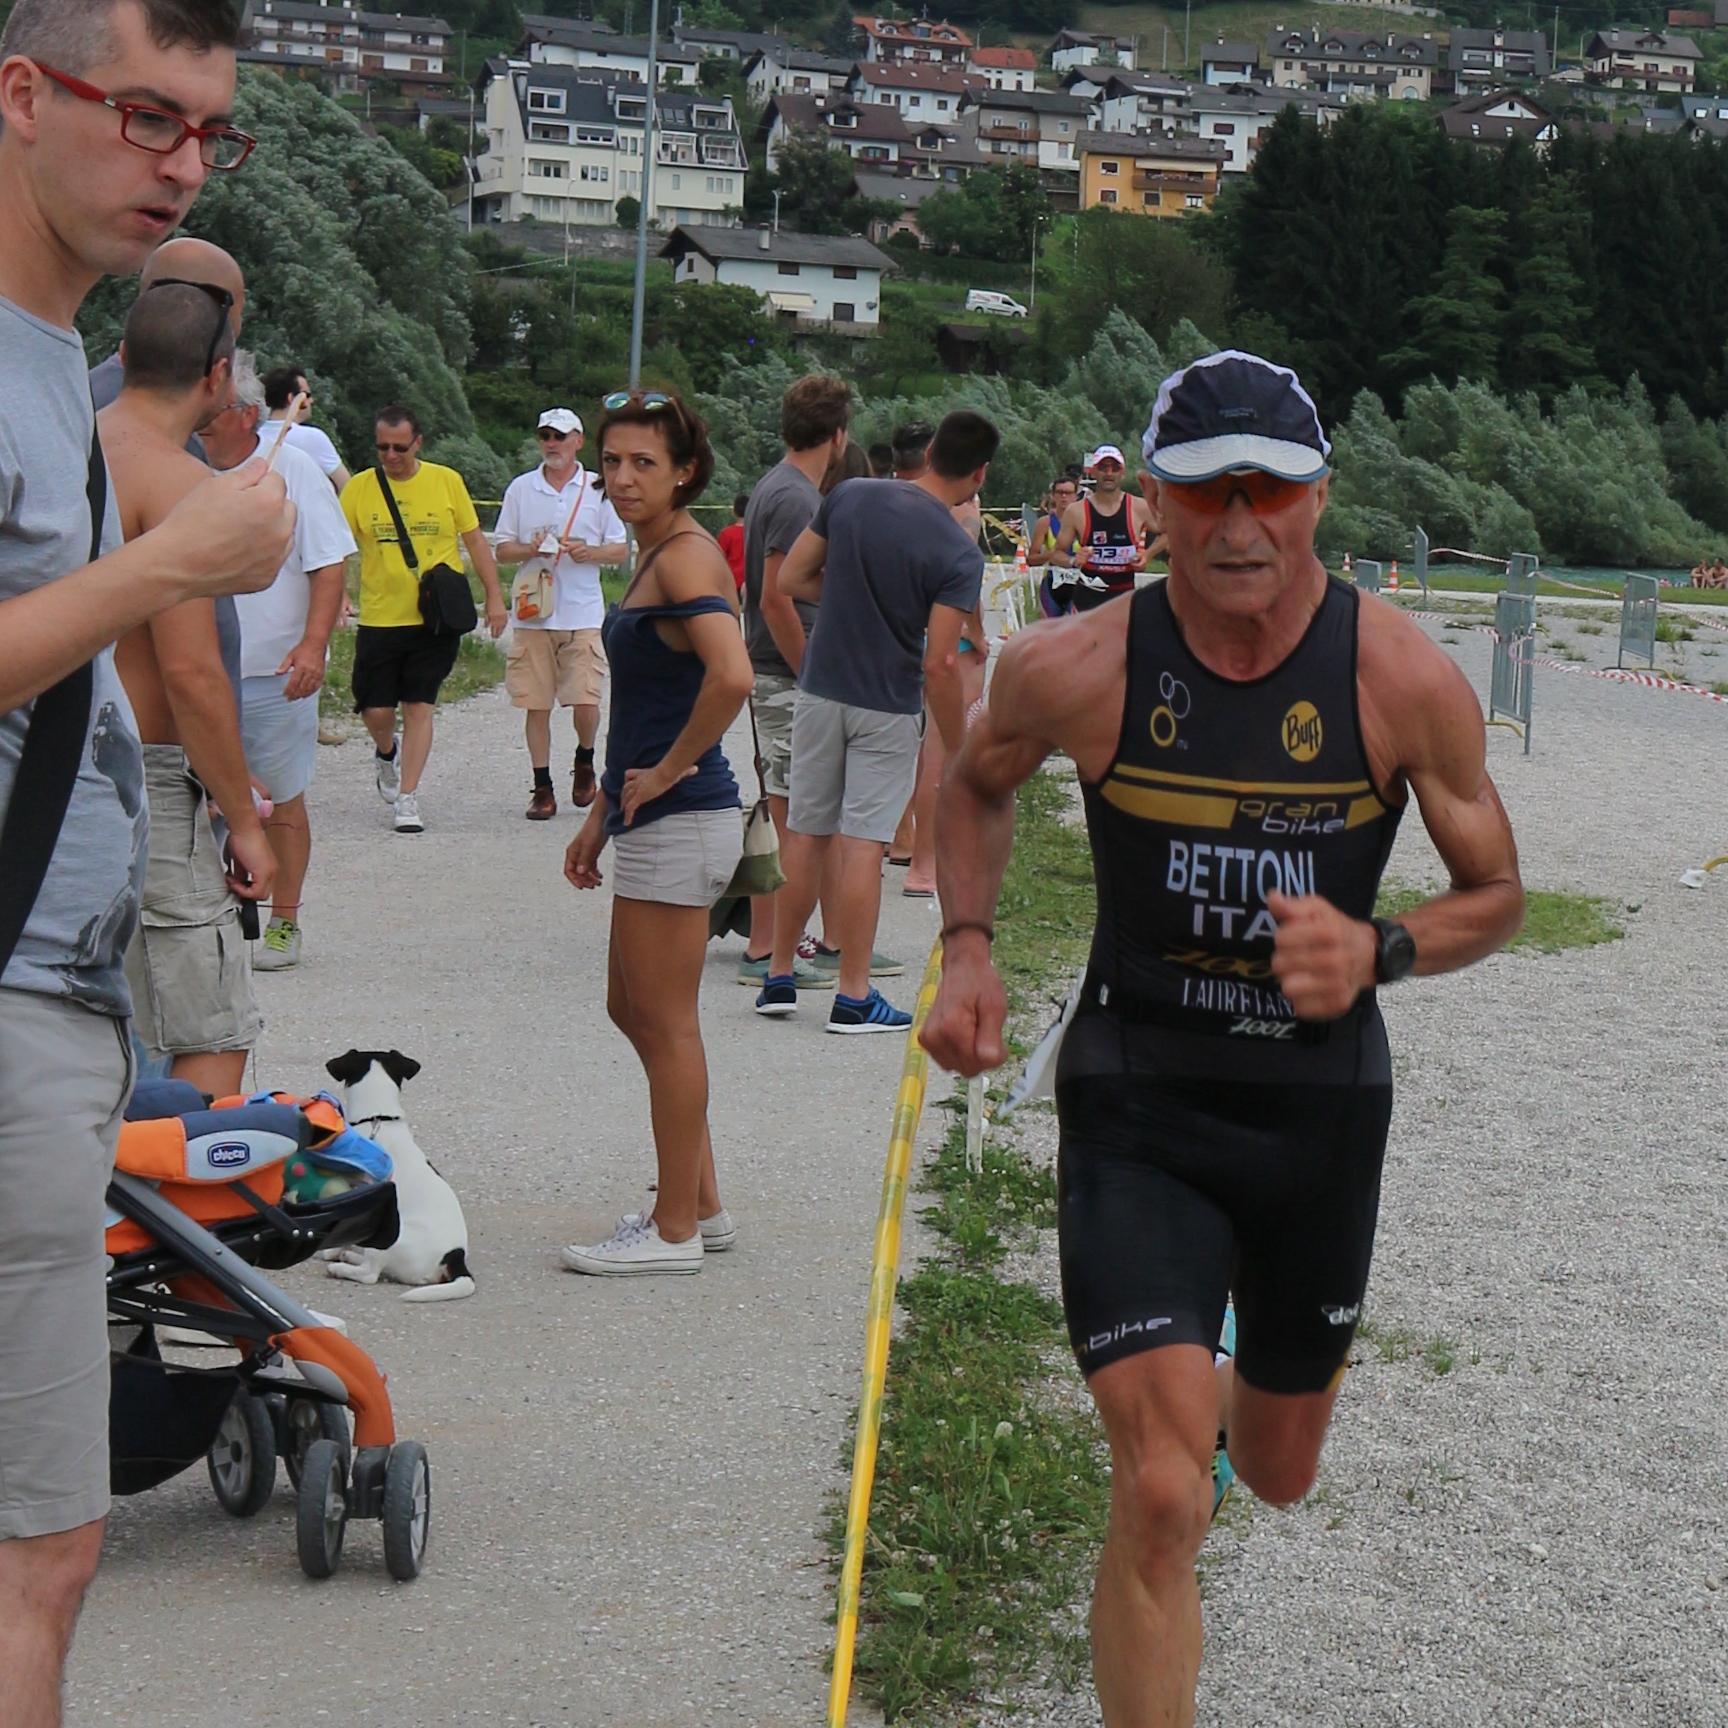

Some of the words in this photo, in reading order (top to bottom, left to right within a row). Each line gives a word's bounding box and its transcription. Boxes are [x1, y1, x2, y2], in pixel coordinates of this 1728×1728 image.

[1239, 799, 1338, 818] gran
[1261, 815, 1345, 835] bike
[1166, 839, 1316, 905] BETTONI
[1192, 903, 1279, 942] ITA
[212, 1148, 246, 1161] chicco
